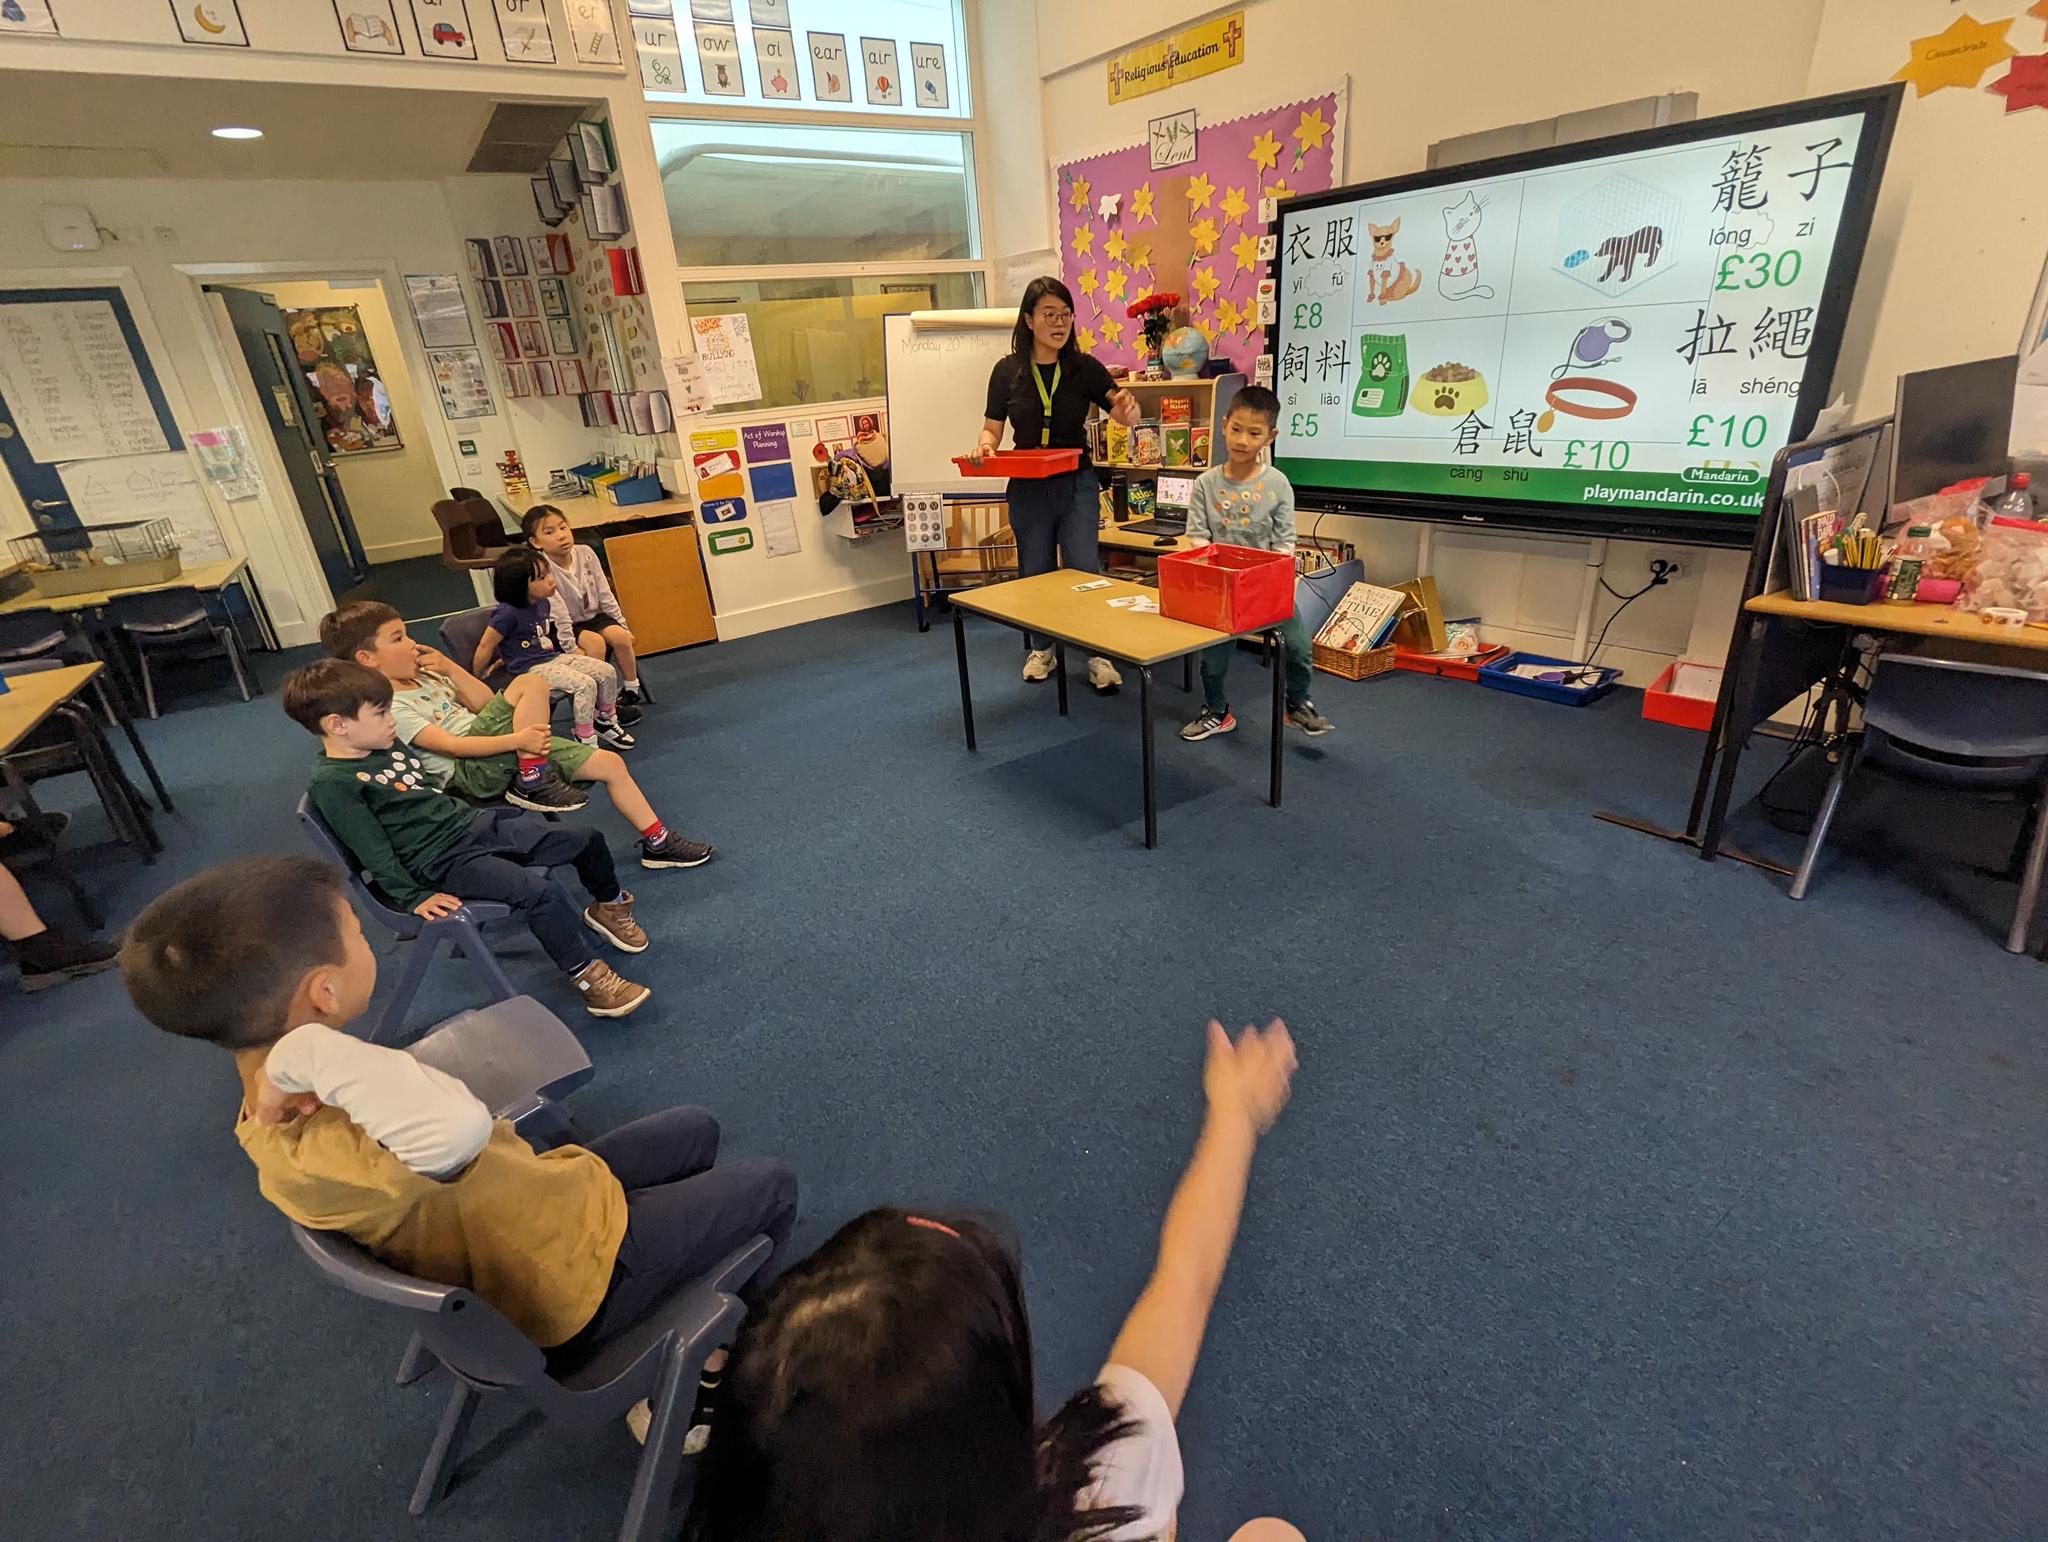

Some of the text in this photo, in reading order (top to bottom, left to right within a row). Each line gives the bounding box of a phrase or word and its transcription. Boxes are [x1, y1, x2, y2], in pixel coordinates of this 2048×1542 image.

[579, 6, 598, 20] er
[644, 30, 667, 47] ur
[703, 36, 730, 52] ow
[767, 41, 782, 57] oi
[814, 45, 842, 61] ear
[868, 49, 891, 65] air
[916, 55, 941, 70] ure
[1124, 43, 1220, 83] Religious Education
[1153, 143, 1193, 165] Lent
[1711, 137, 1853, 213] 籠子
[1284, 216, 1357, 265] 衣服
[1708, 226, 1751, 247] lóng
[1331, 271, 1344, 286] fú
[1715, 249, 1801, 291] £30
[1293, 302, 1323, 330] £8
[1676, 306, 1814, 365] 拉繩
[901, 339, 941, 361] Monday
[1278, 340, 1351, 384] 飼料
[744, 432, 753, 440] Act
[755, 430, 761, 440] of
[763, 429, 785, 438] Worship
[1290, 412, 1319, 437] £5
[1451, 408, 1543, 458] 倉鼠
[1687, 414, 1767, 448] £10
[753, 441, 777, 449] Planning
[1562, 439, 1630, 471] £10
[1690, 468, 1749, 482] Mandarin
[1130, 489, 1154, 501] Atlas
[1584, 484, 1765, 508] playmandarin.co.uk
[1346, 601, 1381, 618] TIME
